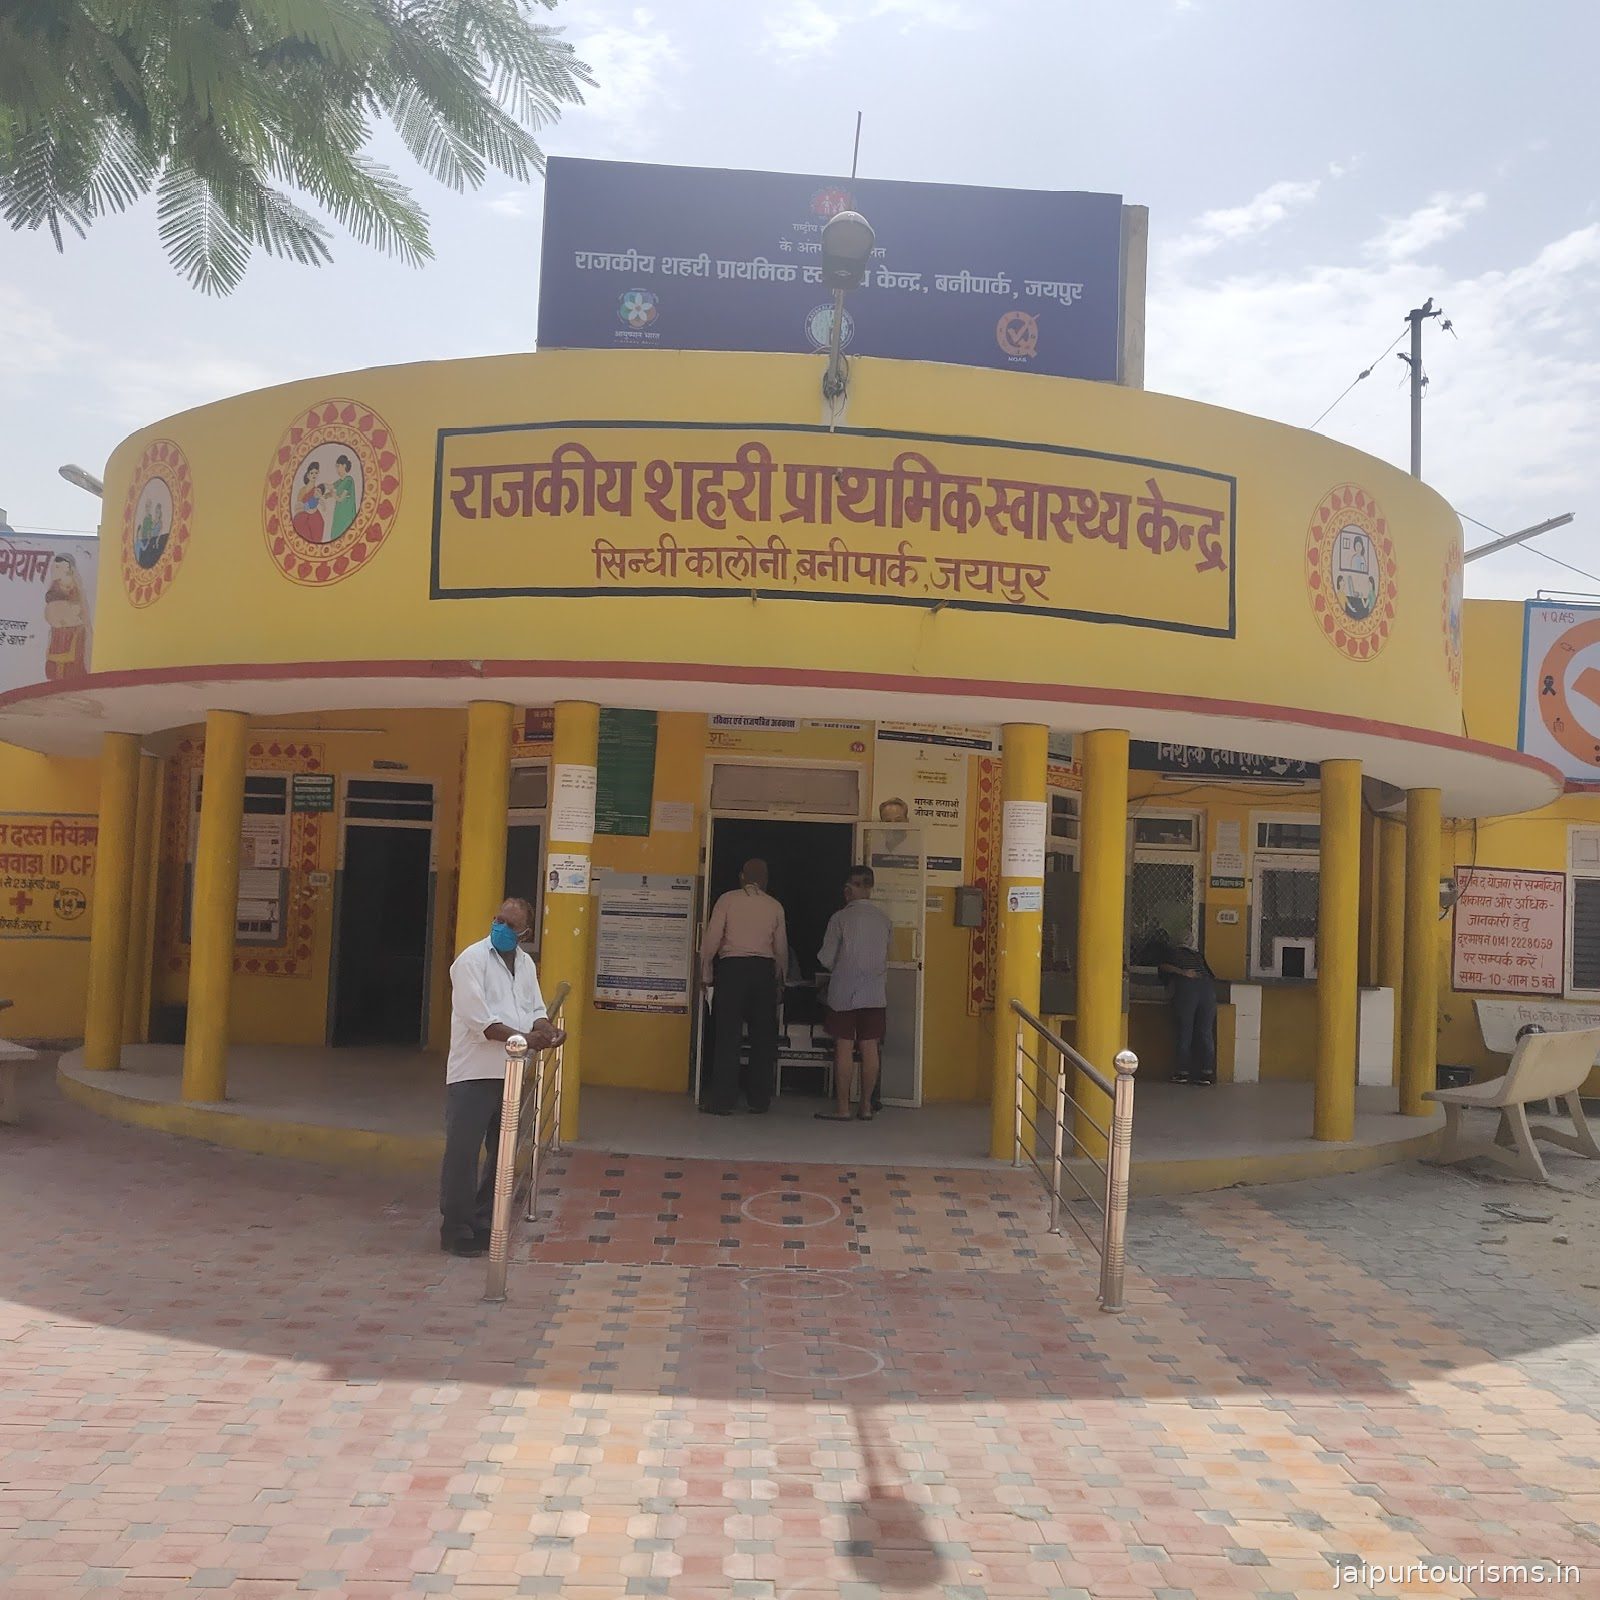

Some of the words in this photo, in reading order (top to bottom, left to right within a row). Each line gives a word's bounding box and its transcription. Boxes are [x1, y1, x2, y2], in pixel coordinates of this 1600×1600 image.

[779, 237, 793, 252] के
[575, 249, 655, 274] राजकीय
[661, 253, 711, 278] शहरी
[716, 256, 798, 282] प्राथमिक
[1024, 280, 1084, 306] जयपुर
[450, 442, 638, 520] राजकीय
[644, 441, 778, 531] शहरी
[779, 451, 982, 534] प्राथमिक
[984, 477, 1133, 550] स्वास्थ्य
[1136, 477, 1228, 575] केन्द्र
[591, 532, 686, 581] सिन्धी
[931, 557, 1051, 604] जयपुर
[935, 798, 960, 808] लगाओ
[936, 808, 959, 819] बचाओ
[11, 825, 48, 848] दस्त
[1513, 875, 1522, 891] से
[1467, 912, 1511, 927] जानकारी
[1513, 915, 1531, 932] हेतु
[1463, 952, 1477, 965] पर
[1507, 974, 1527, 987] शाम
[1531, 975, 1540, 987] 5
